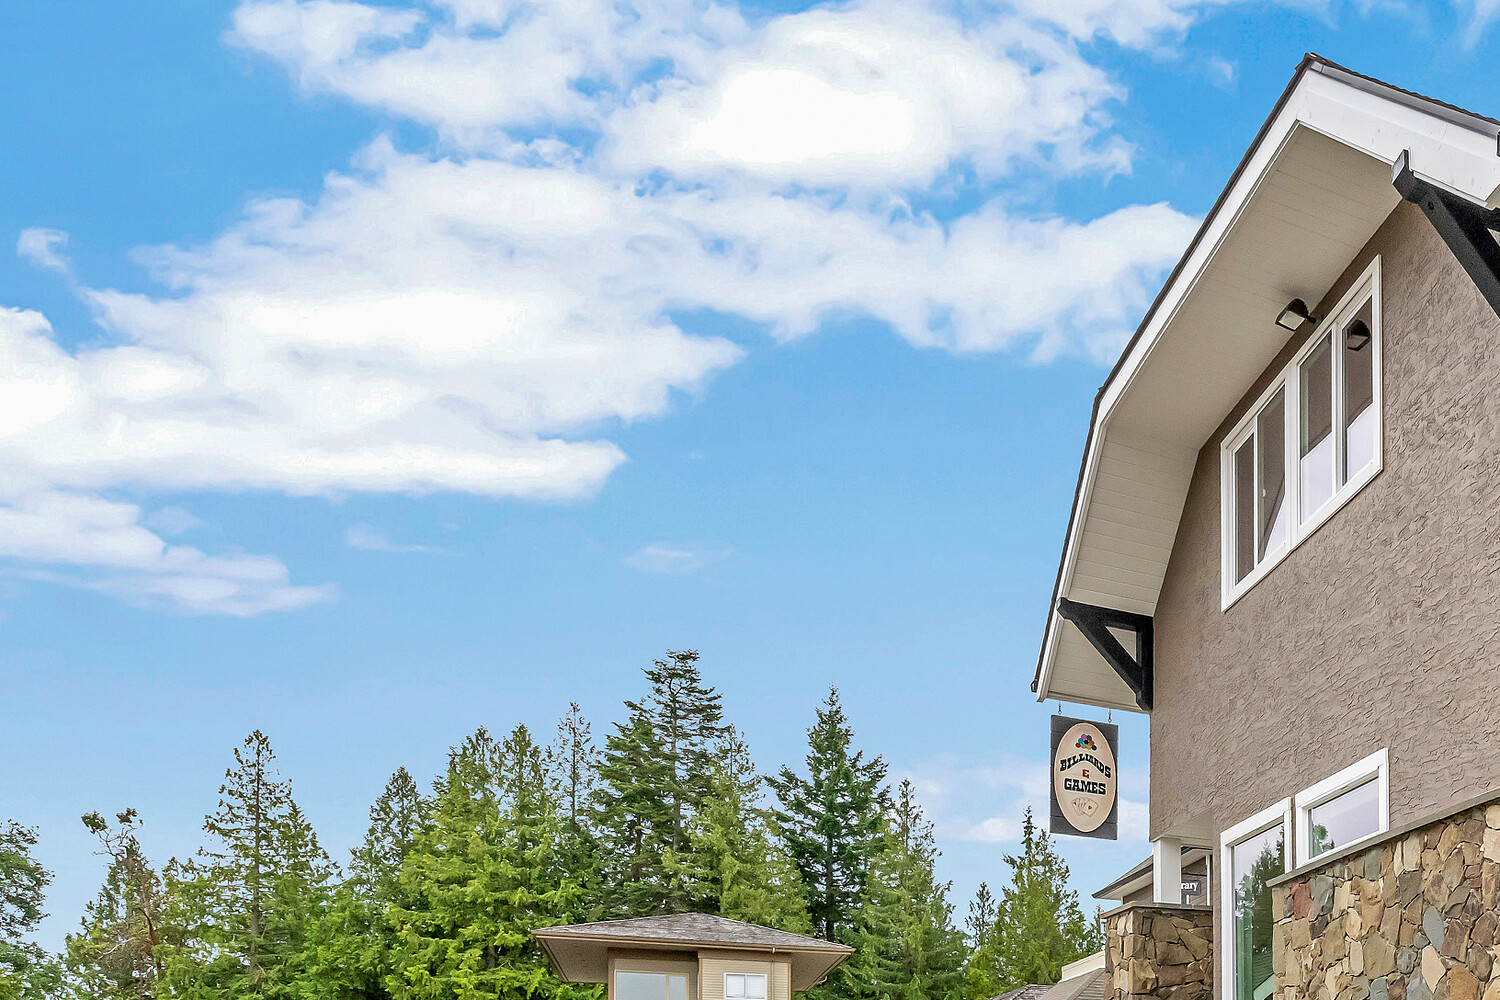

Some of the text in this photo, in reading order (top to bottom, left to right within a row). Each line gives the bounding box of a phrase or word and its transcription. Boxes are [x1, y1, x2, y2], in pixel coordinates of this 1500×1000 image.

[1060, 753, 1111, 778] BILLIARDS
[1064, 778, 1106, 795] GAMES
[1181, 882, 1199, 891] rary
